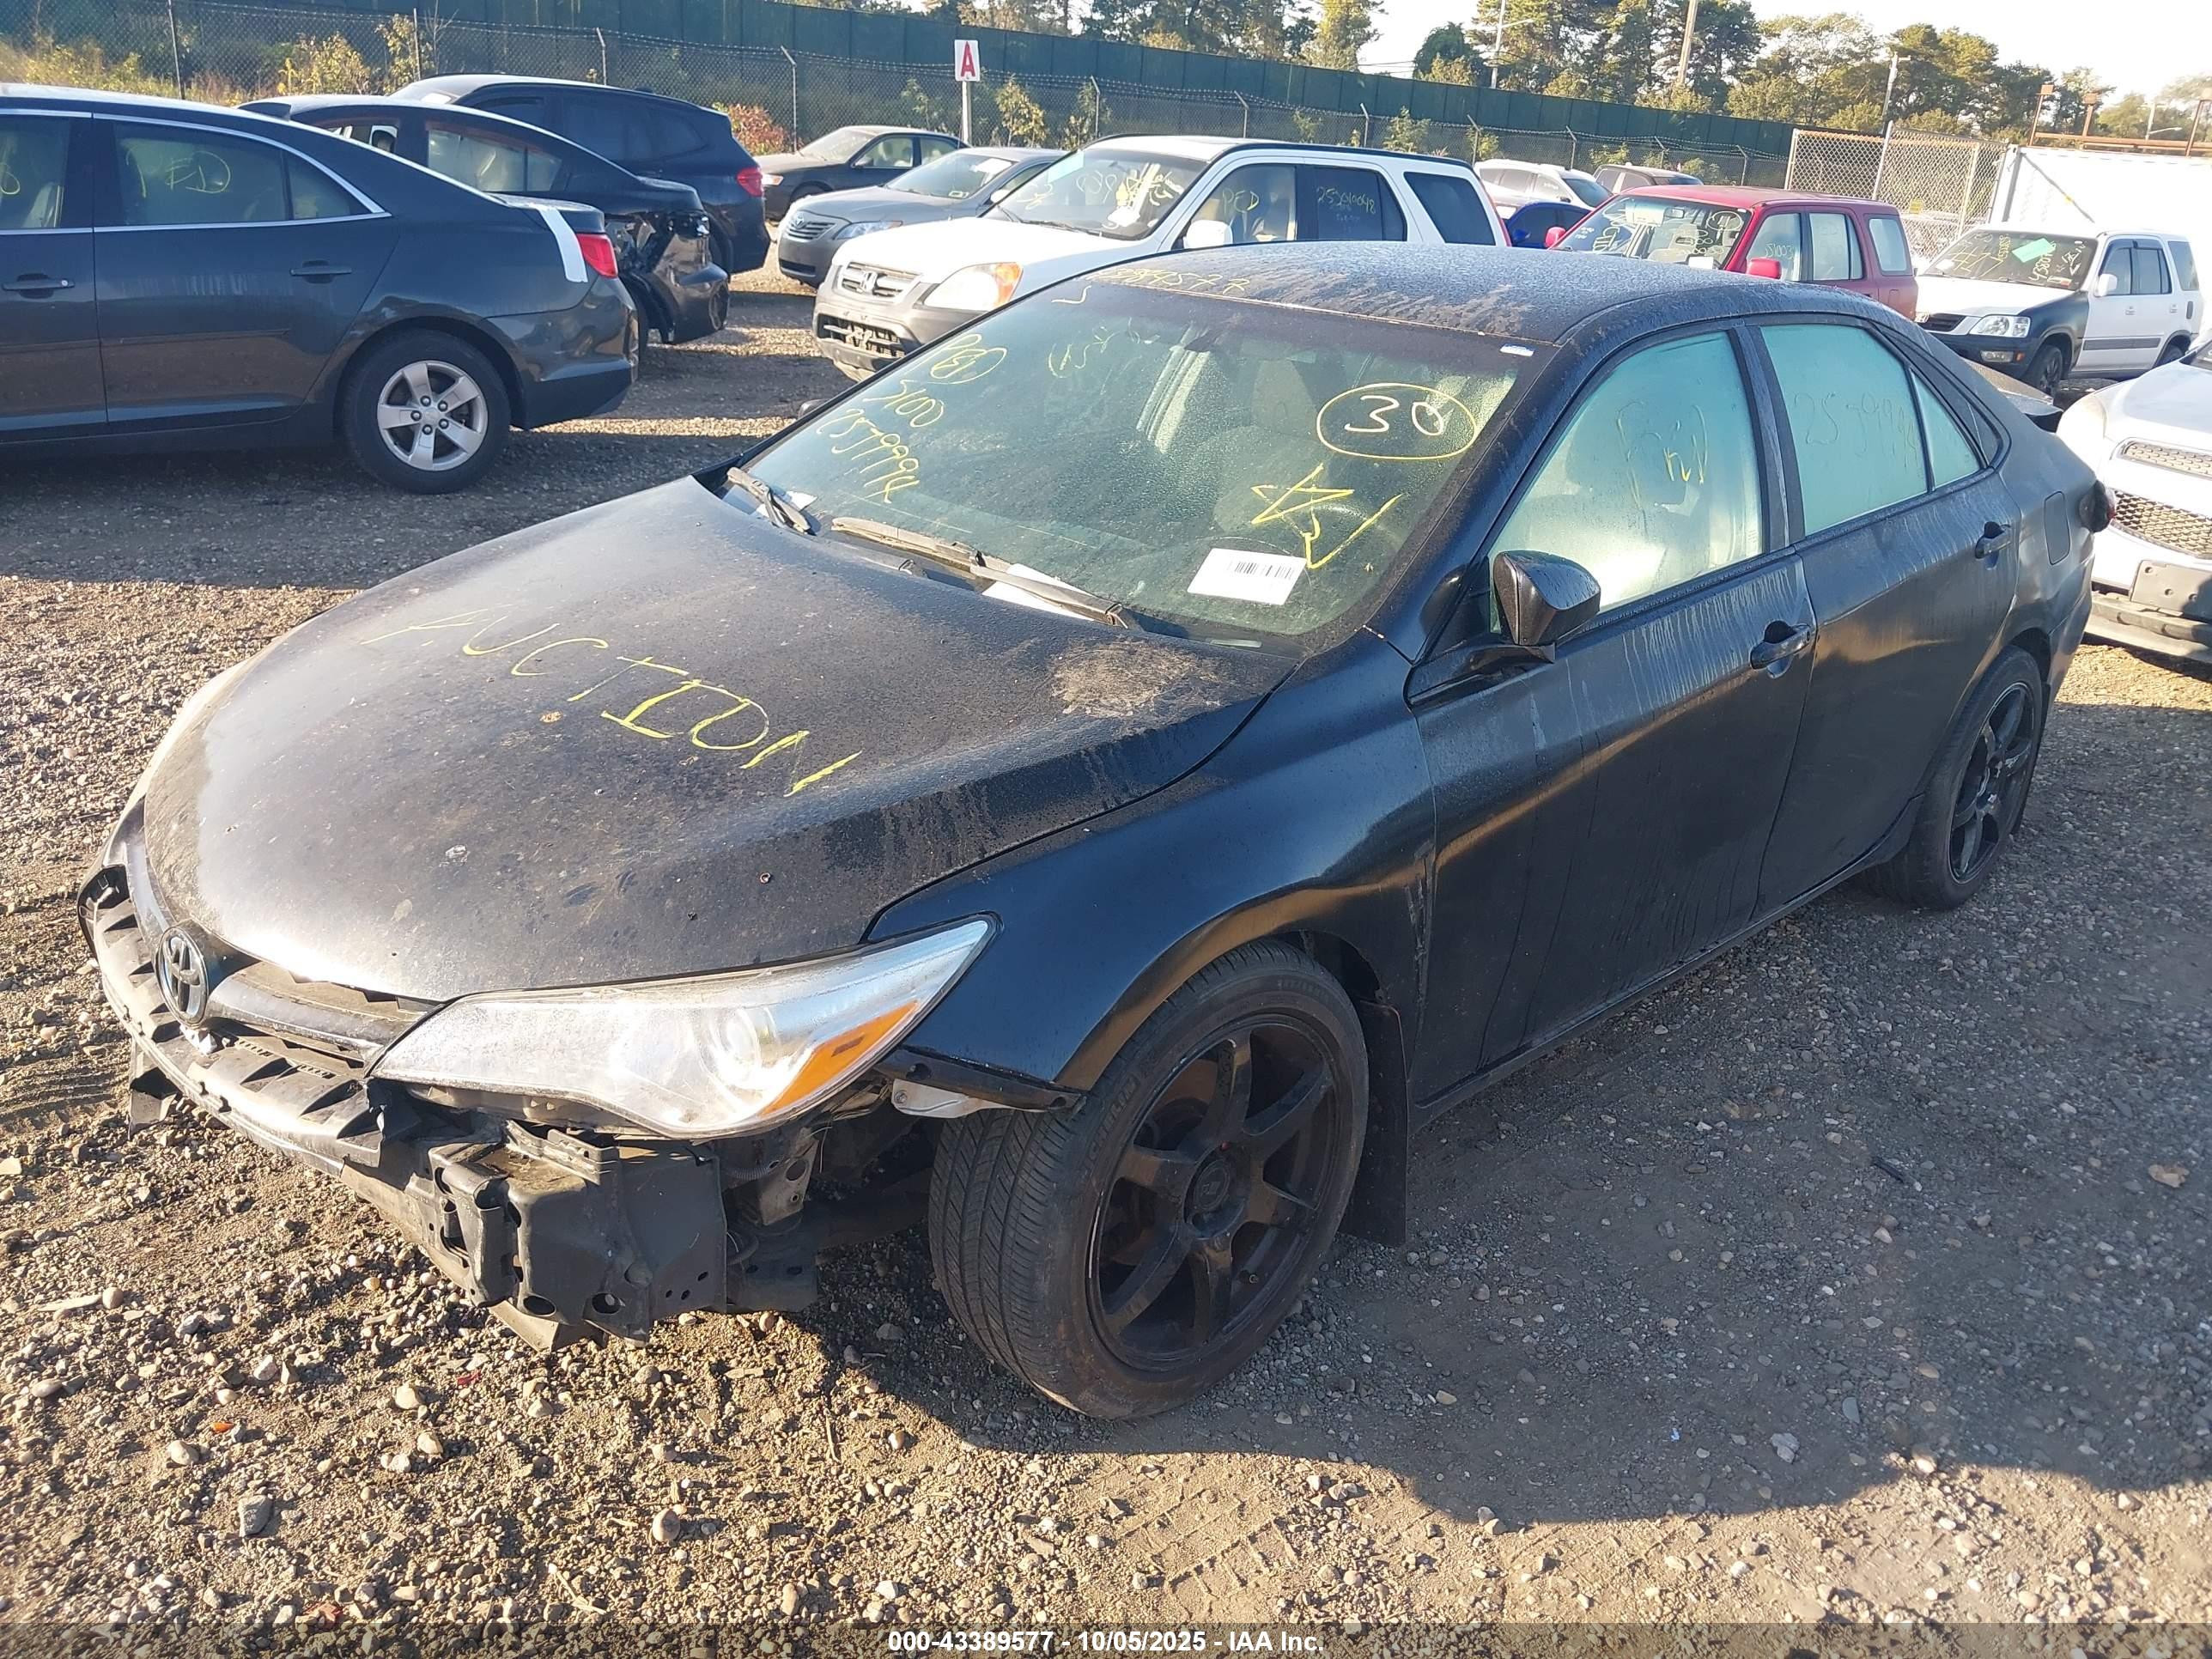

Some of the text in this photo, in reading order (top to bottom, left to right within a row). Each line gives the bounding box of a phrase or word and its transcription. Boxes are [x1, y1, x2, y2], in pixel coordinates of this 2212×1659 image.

[961, 41, 975, 77] A
[1222, 187, 1260, 214] PED
[1344, 395, 1444, 436] 30
[361, 604, 862, 797] AUCTION
